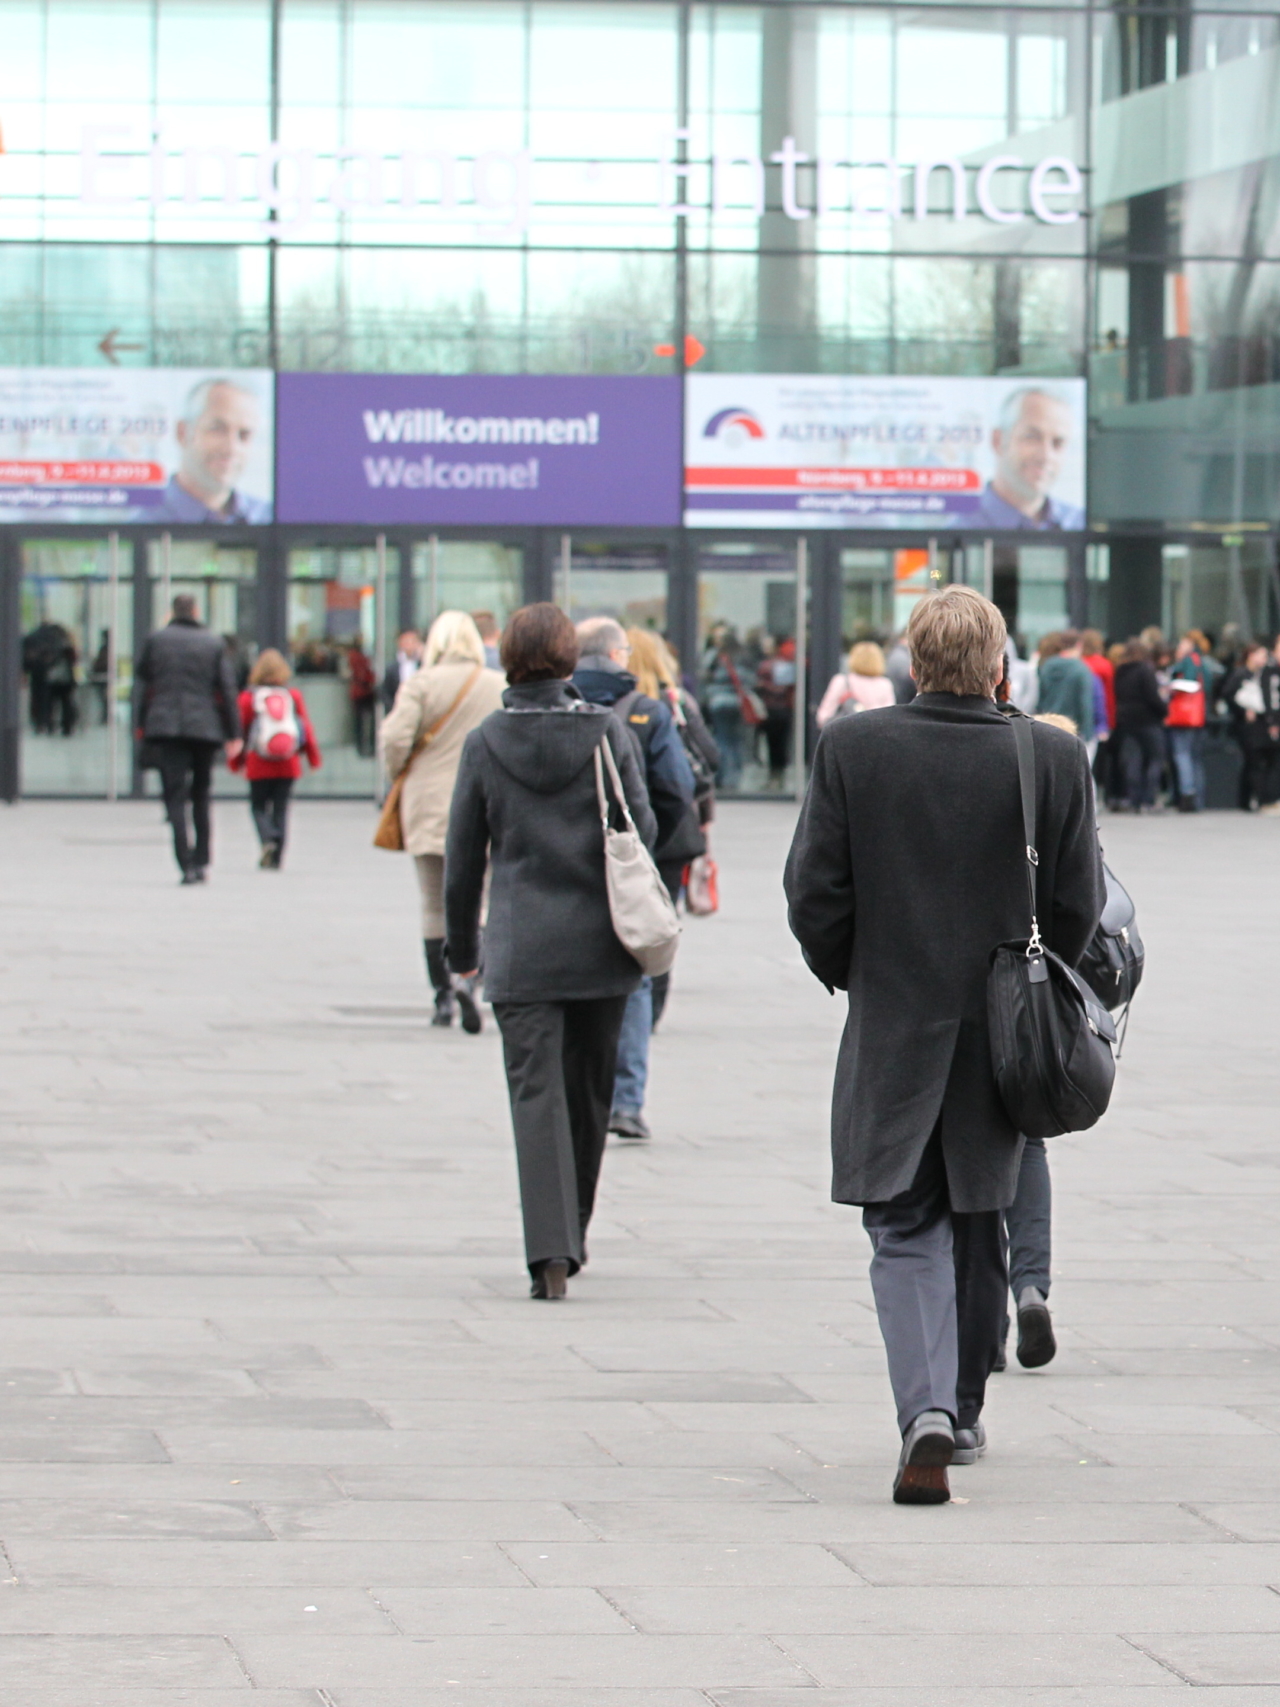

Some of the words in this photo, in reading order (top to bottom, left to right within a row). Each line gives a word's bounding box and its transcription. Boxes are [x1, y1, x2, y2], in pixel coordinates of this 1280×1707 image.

[81, 121, 531, 237] Eingang
[659, 127, 1083, 224] Entrance
[363, 408, 599, 444] Willkommen!
[778, 422, 929, 443] ALTENPFLEGE
[363, 454, 539, 489] Welcome!
